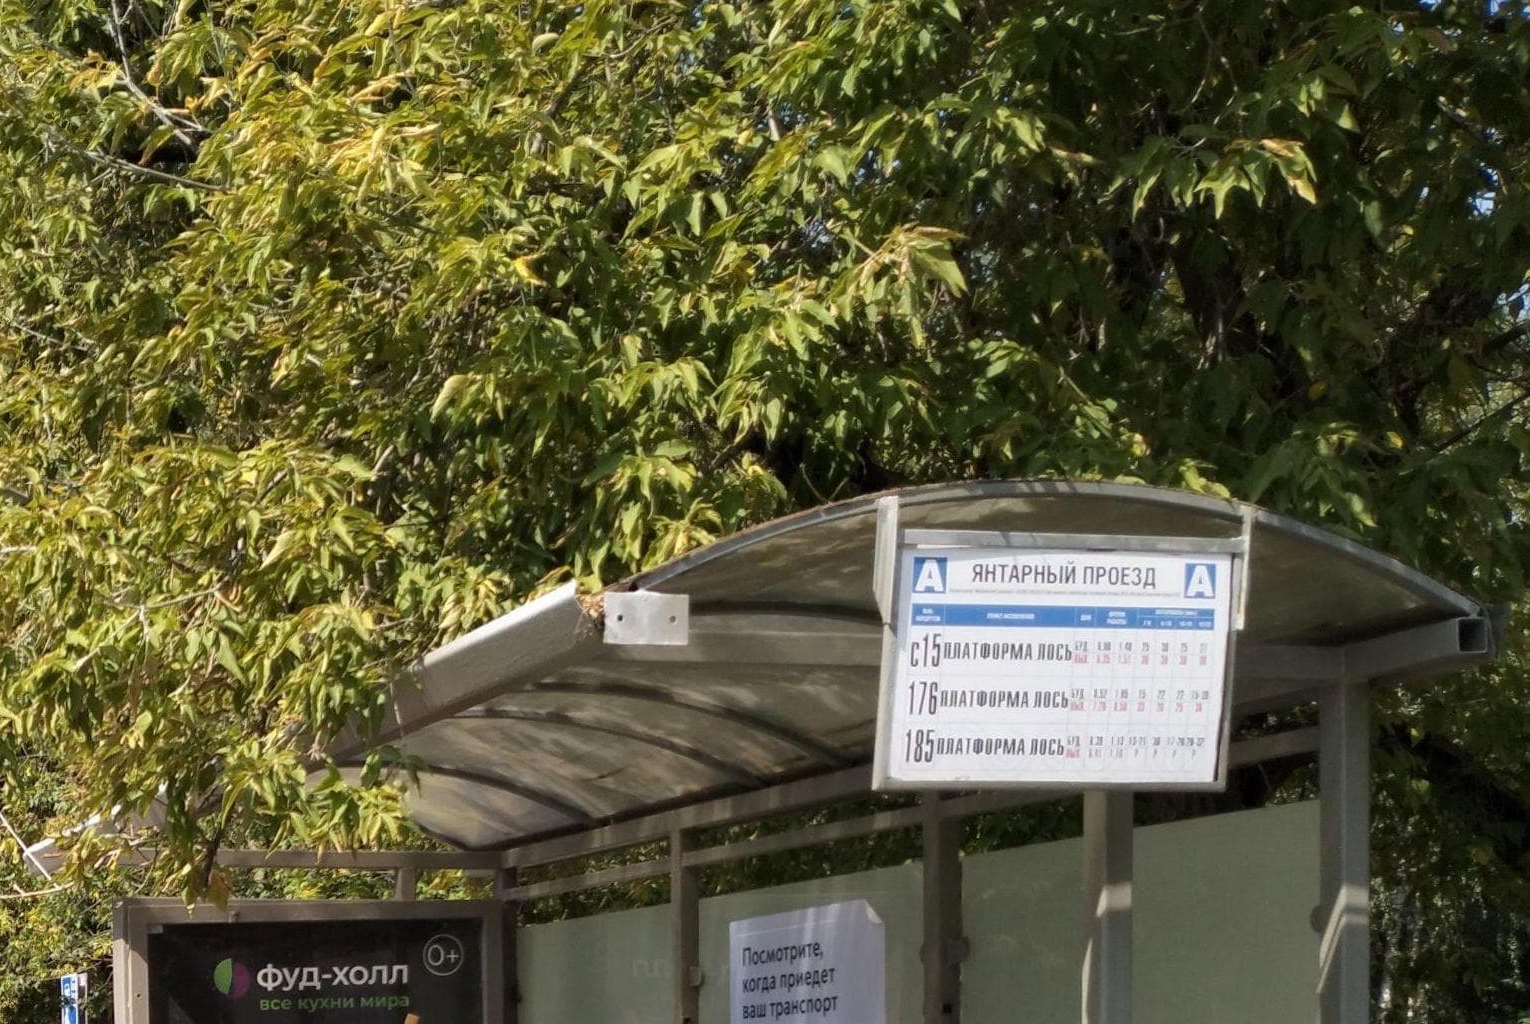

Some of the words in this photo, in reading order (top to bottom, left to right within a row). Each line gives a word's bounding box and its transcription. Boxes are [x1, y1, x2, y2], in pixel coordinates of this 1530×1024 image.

[972, 561, 1076, 584] ЯНТАРНЫЙ
[1083, 566, 1156, 589] ПРОЕЗД
[943, 641, 1033, 660] ПЛАТФОРМА
[1036, 643, 1072, 661] ЛОСЬ
[909, 681, 938, 715] 176
[940, 689, 1029, 708] ПЛАТФОРМА
[1033, 691, 1069, 708] ЛОСЬ
[906, 729, 935, 763] 185
[936, 738, 1025, 755] ПЛАТФОРМА
[1029, 738, 1064, 756] ЛОСЬ
[427, 944, 460, 967] 0+
[743, 942, 823, 967] Посмотрите,
[256, 963, 409, 992] фуд-холл
[742, 975, 776, 993] когда
[780, 968, 835, 992] приедет
[259, 998, 292, 1011] все
[298, 997, 355, 1013] кухни
[360, 994, 410, 1010] мира
[742, 1003, 766, 1019] ваш
[770, 996, 838, 1021] транспорт
